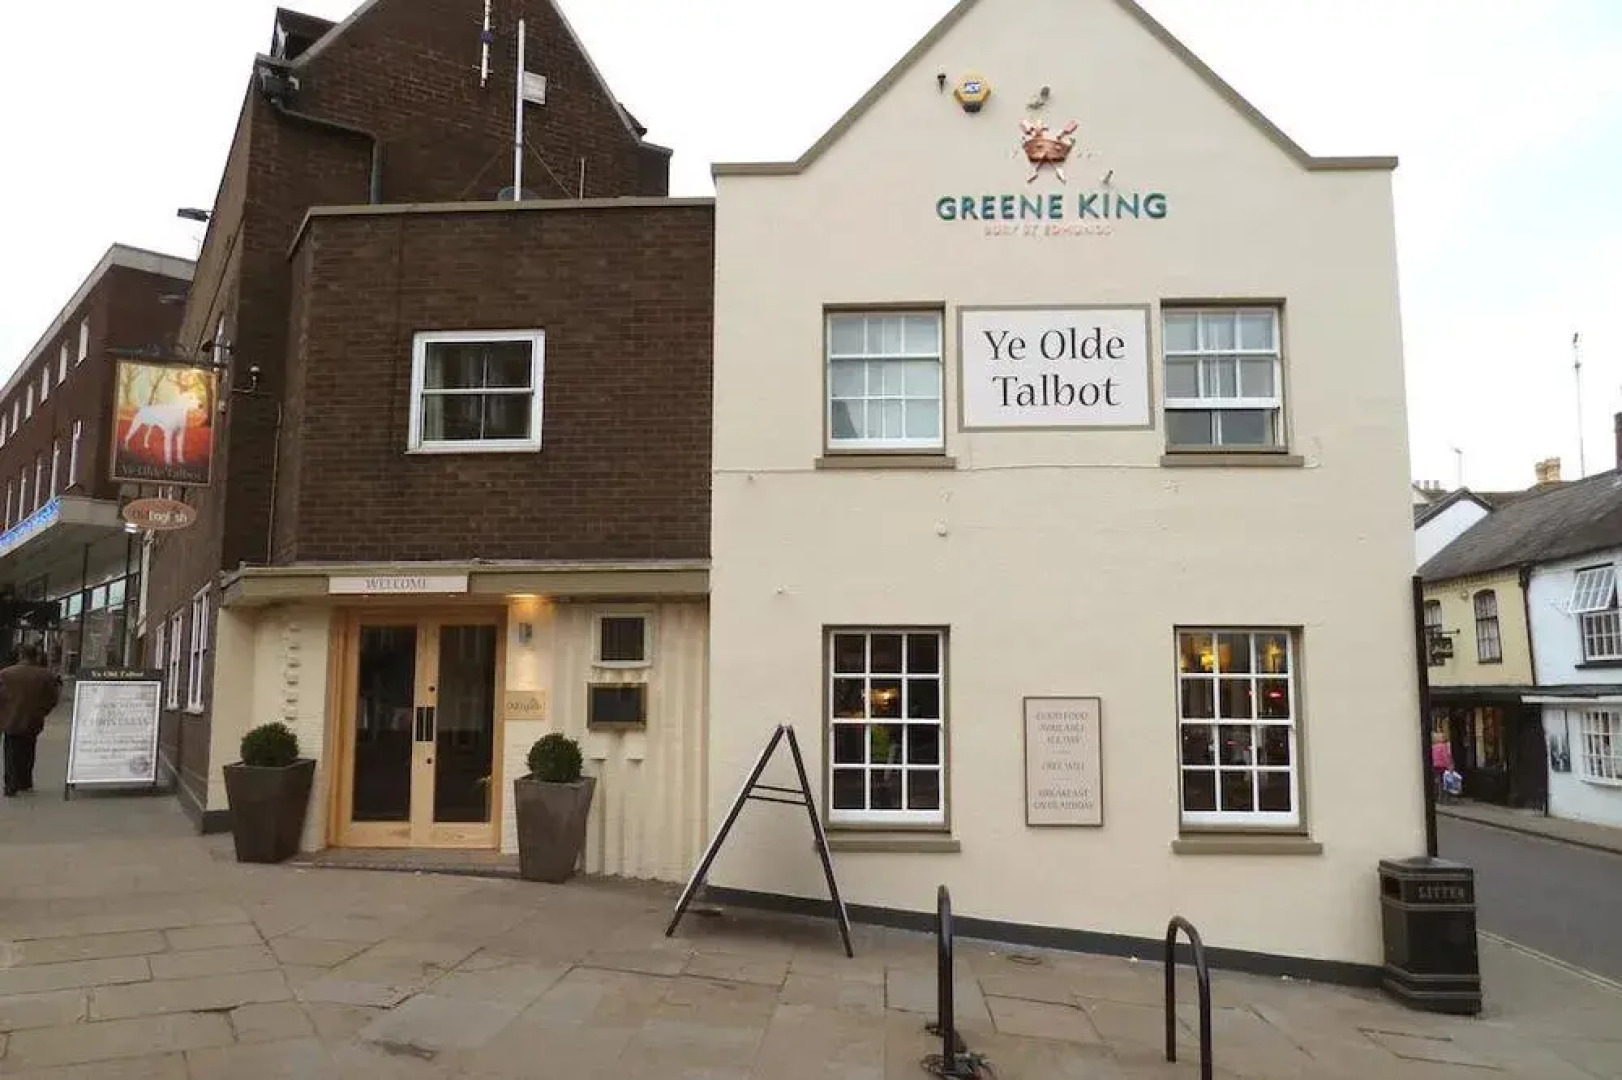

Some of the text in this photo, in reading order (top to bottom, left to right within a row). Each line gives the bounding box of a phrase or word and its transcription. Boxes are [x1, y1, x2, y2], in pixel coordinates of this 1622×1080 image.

[936, 192, 1167, 220] GREENE KING
[983, 327, 1125, 361] Ye Olde
[992, 374, 1122, 407] Talbot
[365, 578, 426, 590] WELCOME
